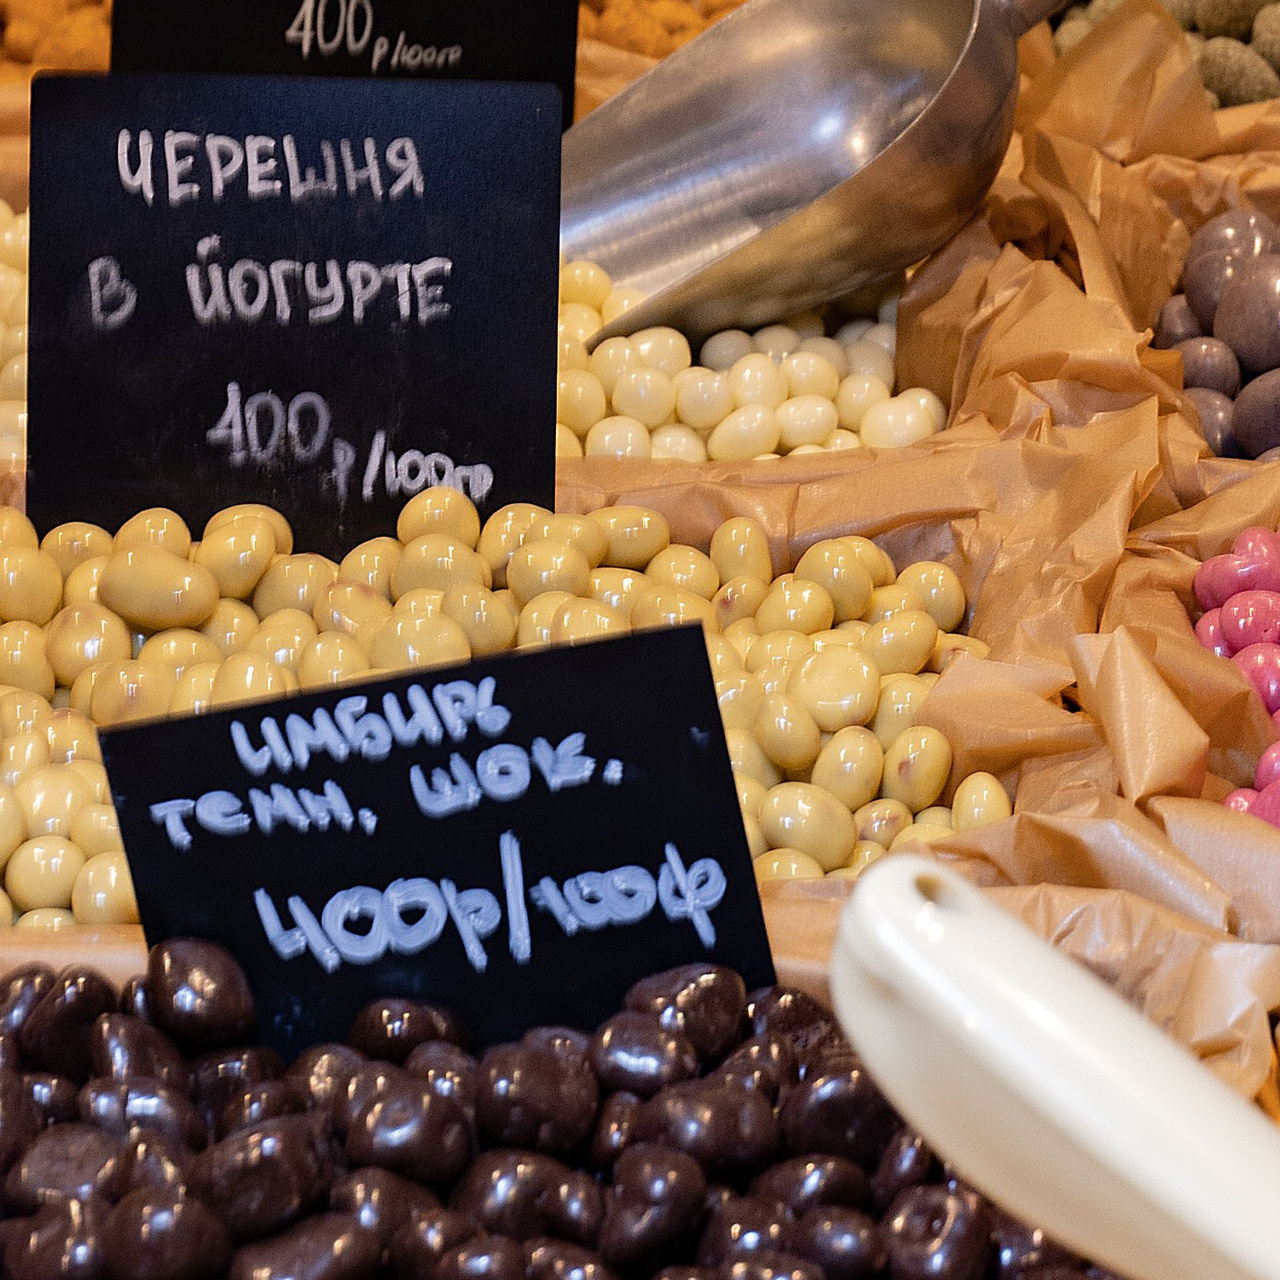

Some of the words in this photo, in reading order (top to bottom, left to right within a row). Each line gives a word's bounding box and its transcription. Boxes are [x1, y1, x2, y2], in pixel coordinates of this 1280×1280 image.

[118, 129, 424, 203] ЧЕРЕШНЯ
[88, 258, 136, 327] В
[186, 235, 452, 322] ЙОГУРТЕ
[231, 676, 511, 775] ИМБИРЬ
[409, 732, 623, 817] ШОК.
